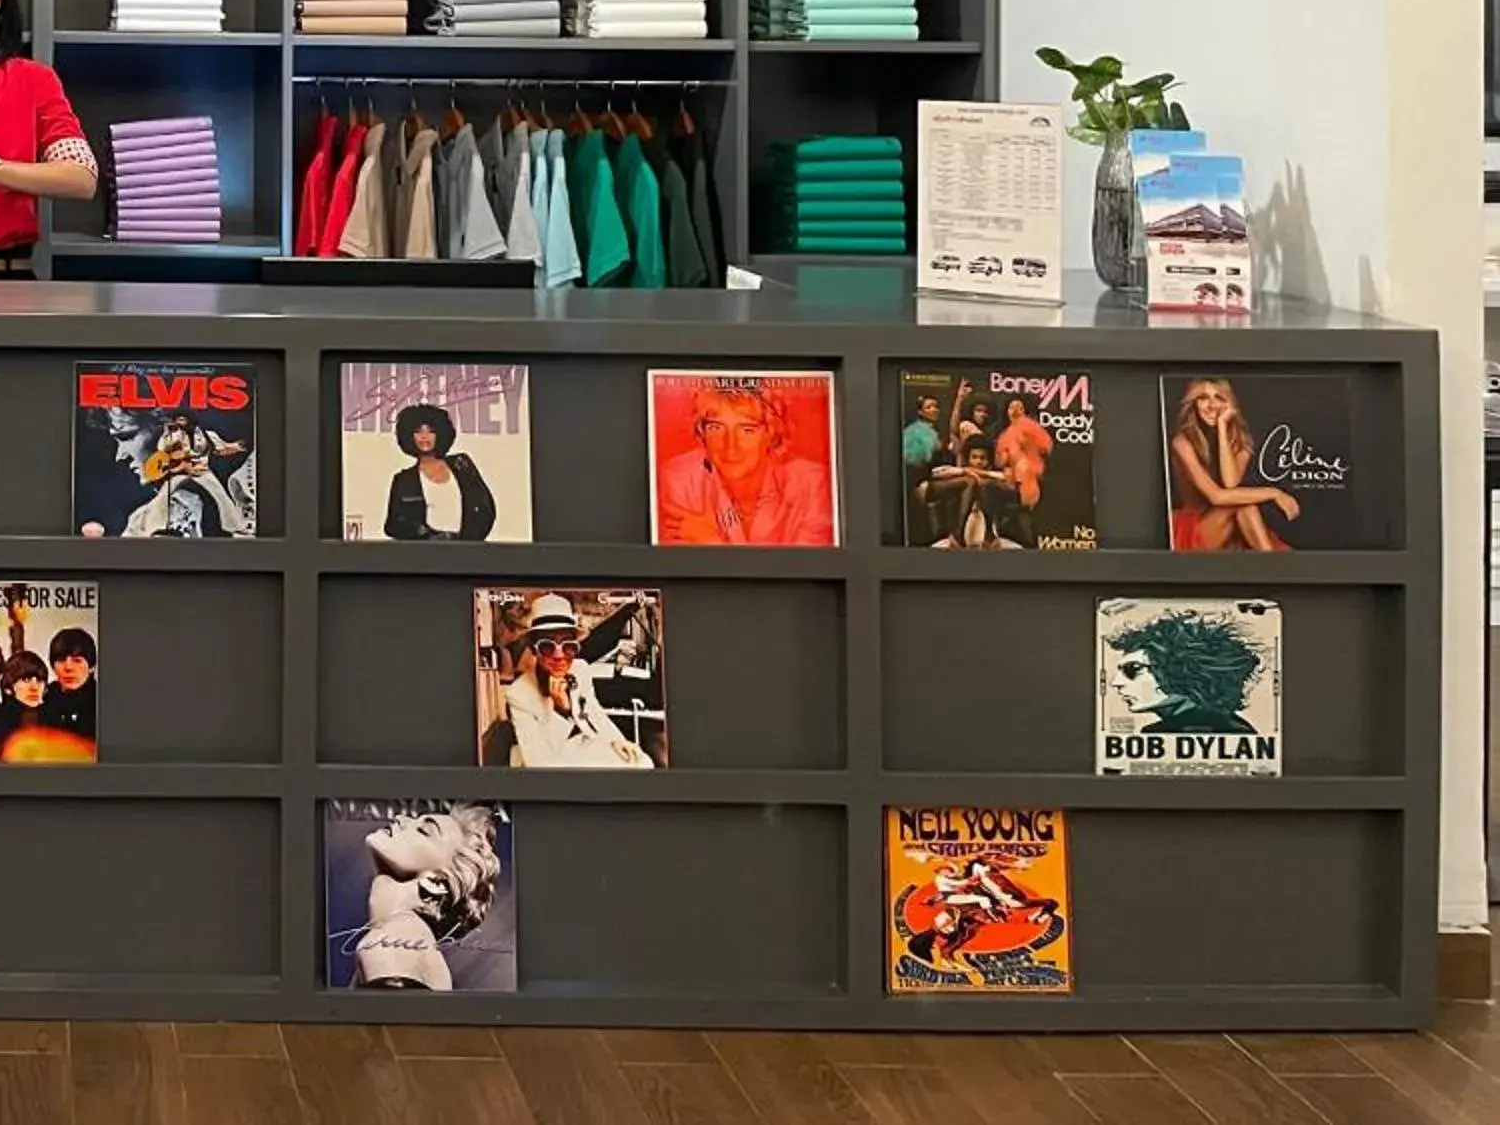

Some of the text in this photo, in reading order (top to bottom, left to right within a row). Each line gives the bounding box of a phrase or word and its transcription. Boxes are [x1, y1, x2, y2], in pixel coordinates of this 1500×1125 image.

[79, 374, 249, 411] ELVIS
[1040, 412, 1094, 430] Daddy
[1056, 428, 1094, 444] Cool
[1292, 472, 1344, 480] DION
[1074, 526, 1096, 540] No
[54, 587, 96, 609] SALE
[1105, 736, 1276, 760] BOB DYLAN
[900, 809, 1055, 842] NEIL YOUNG
